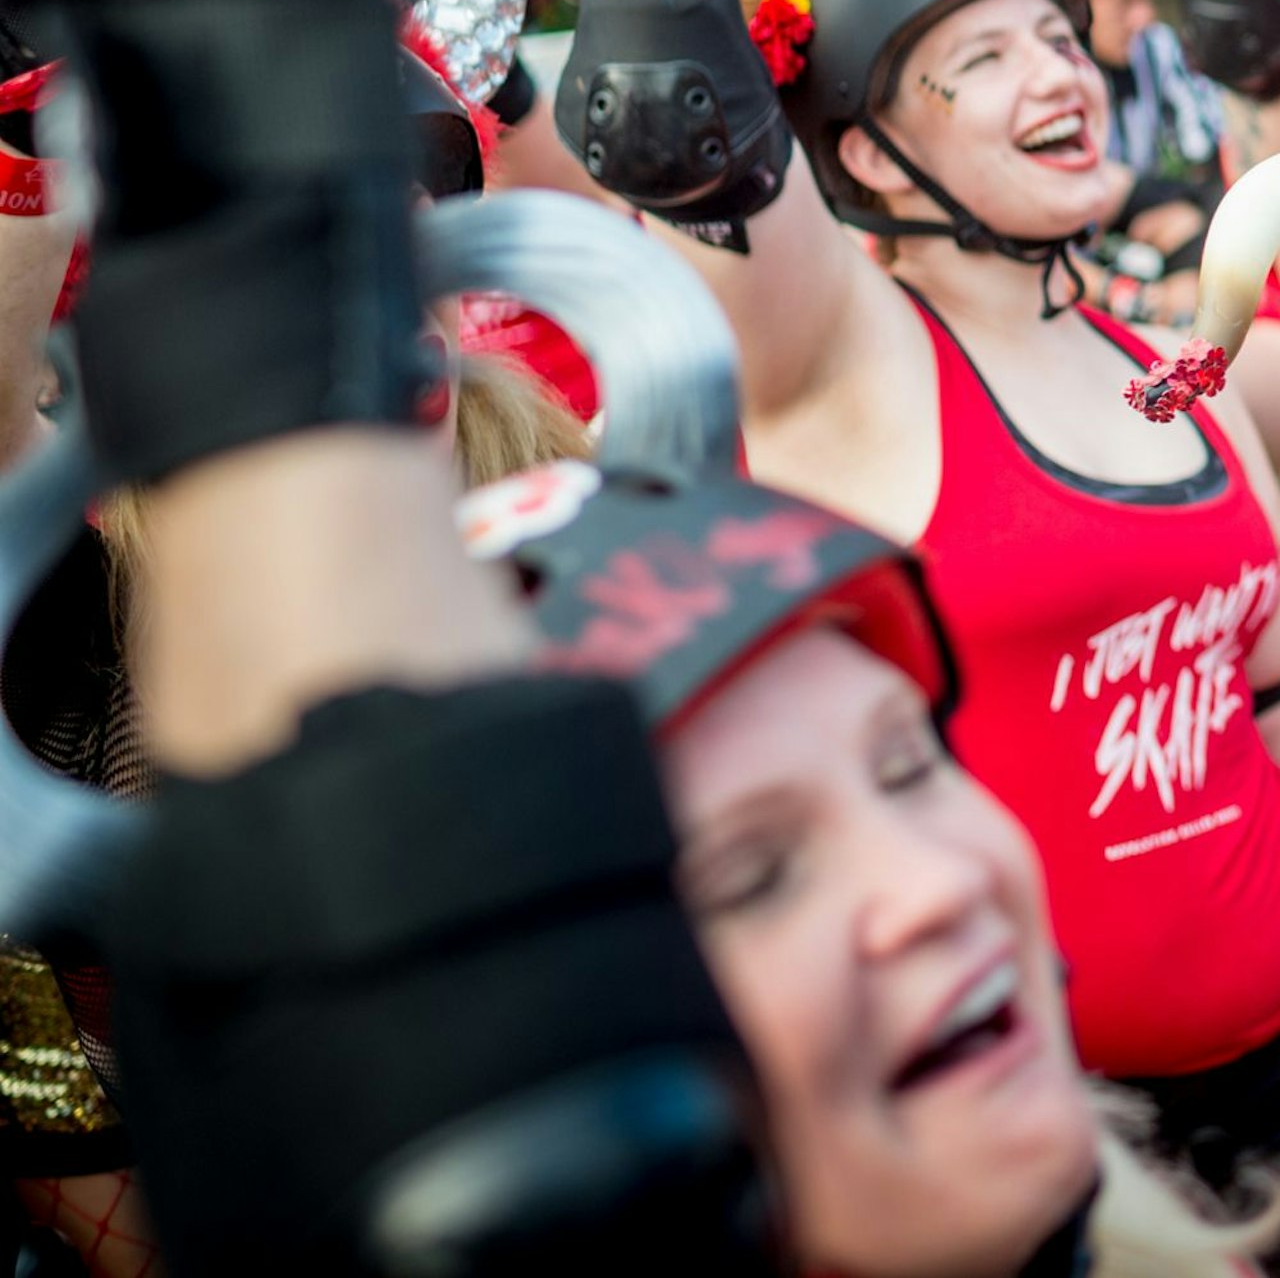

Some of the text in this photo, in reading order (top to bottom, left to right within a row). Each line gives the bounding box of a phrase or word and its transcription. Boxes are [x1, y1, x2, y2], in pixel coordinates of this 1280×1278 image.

[1051, 653, 1074, 712] I
[1083, 596, 1178, 699] JUST
[1089, 627, 1244, 818] SKATE
